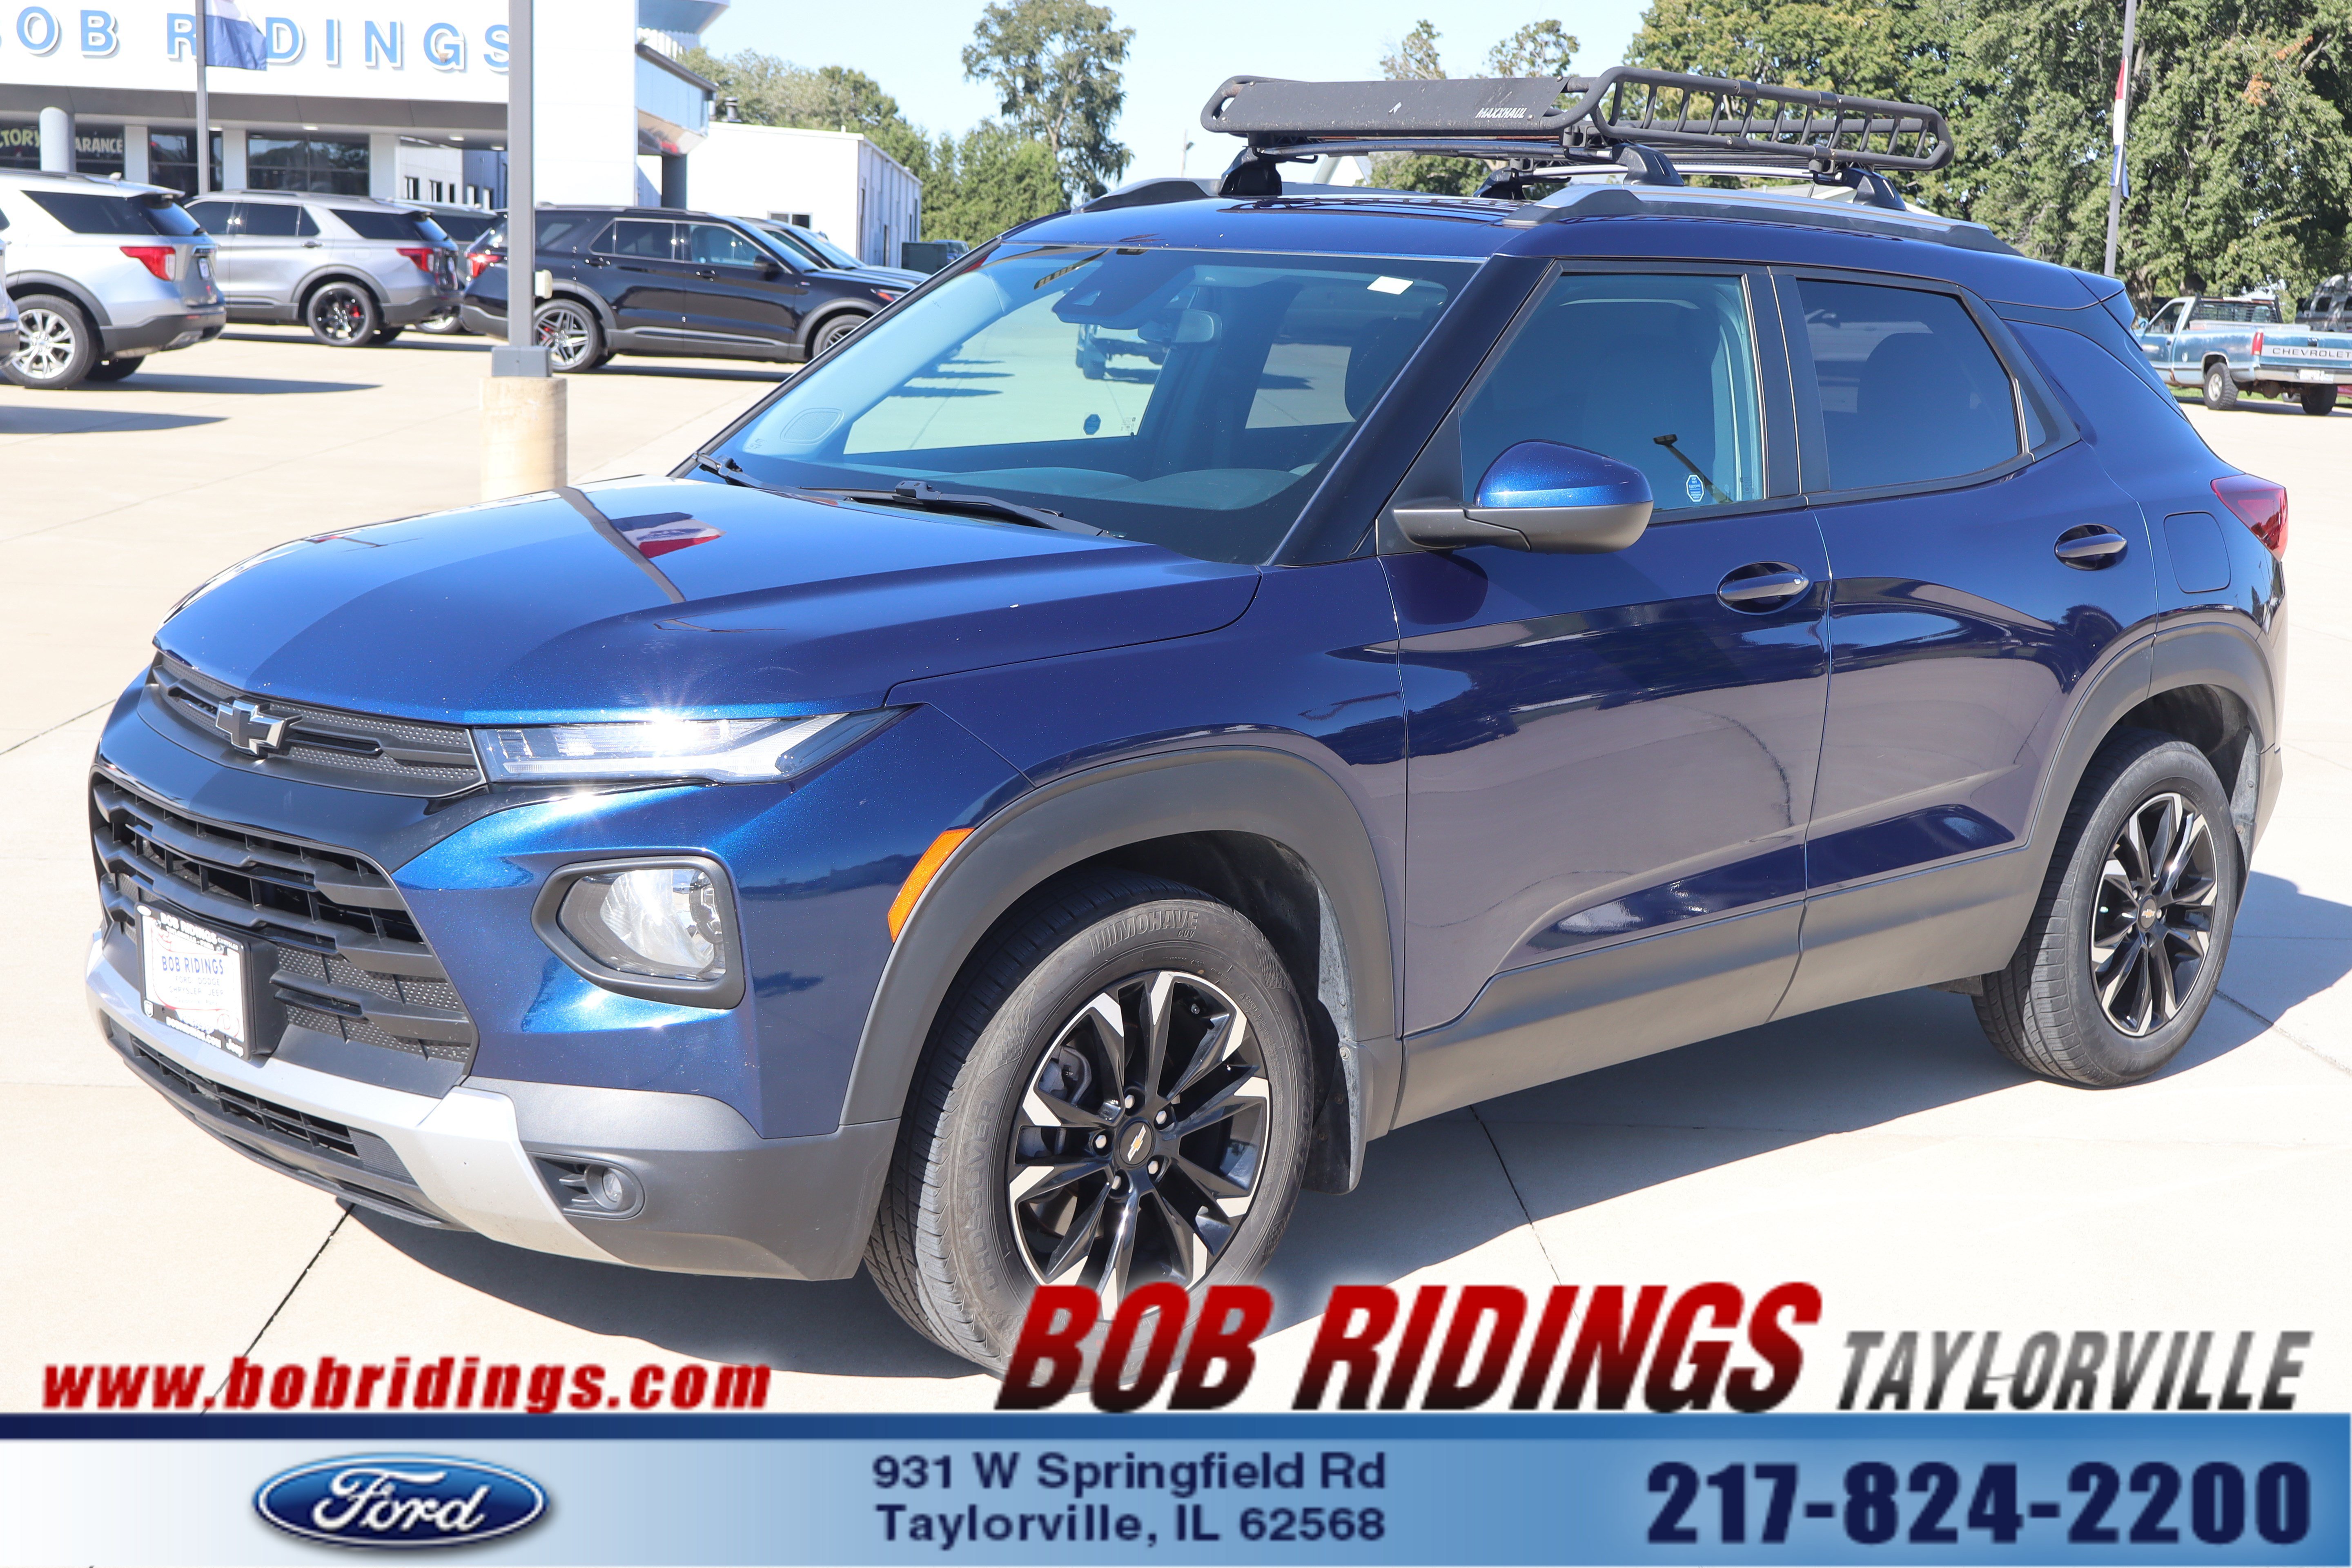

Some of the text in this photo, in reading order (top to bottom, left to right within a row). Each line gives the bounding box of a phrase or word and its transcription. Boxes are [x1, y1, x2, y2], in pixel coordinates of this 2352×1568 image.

[0, 6, 510, 73] OB RDINGS
[1475, 107, 1527, 118] MAXXHAUL
[75, 137, 122, 153] ARANCE
[2272, 347, 2352, 358] CHEVROLET
[1116, 910, 1199, 940] MOHAVE
[1177, 930, 1195, 938] CUV
[162, 956, 224, 975] BOB RIDINGS
[176, 976, 220, 986] FORD DODGE
[169, 986, 201, 995] CHRYSLER
[1245, 995, 1270, 1036] SAFETY WARNING
[967, 1100, 999, 1292] CROSSOVER
